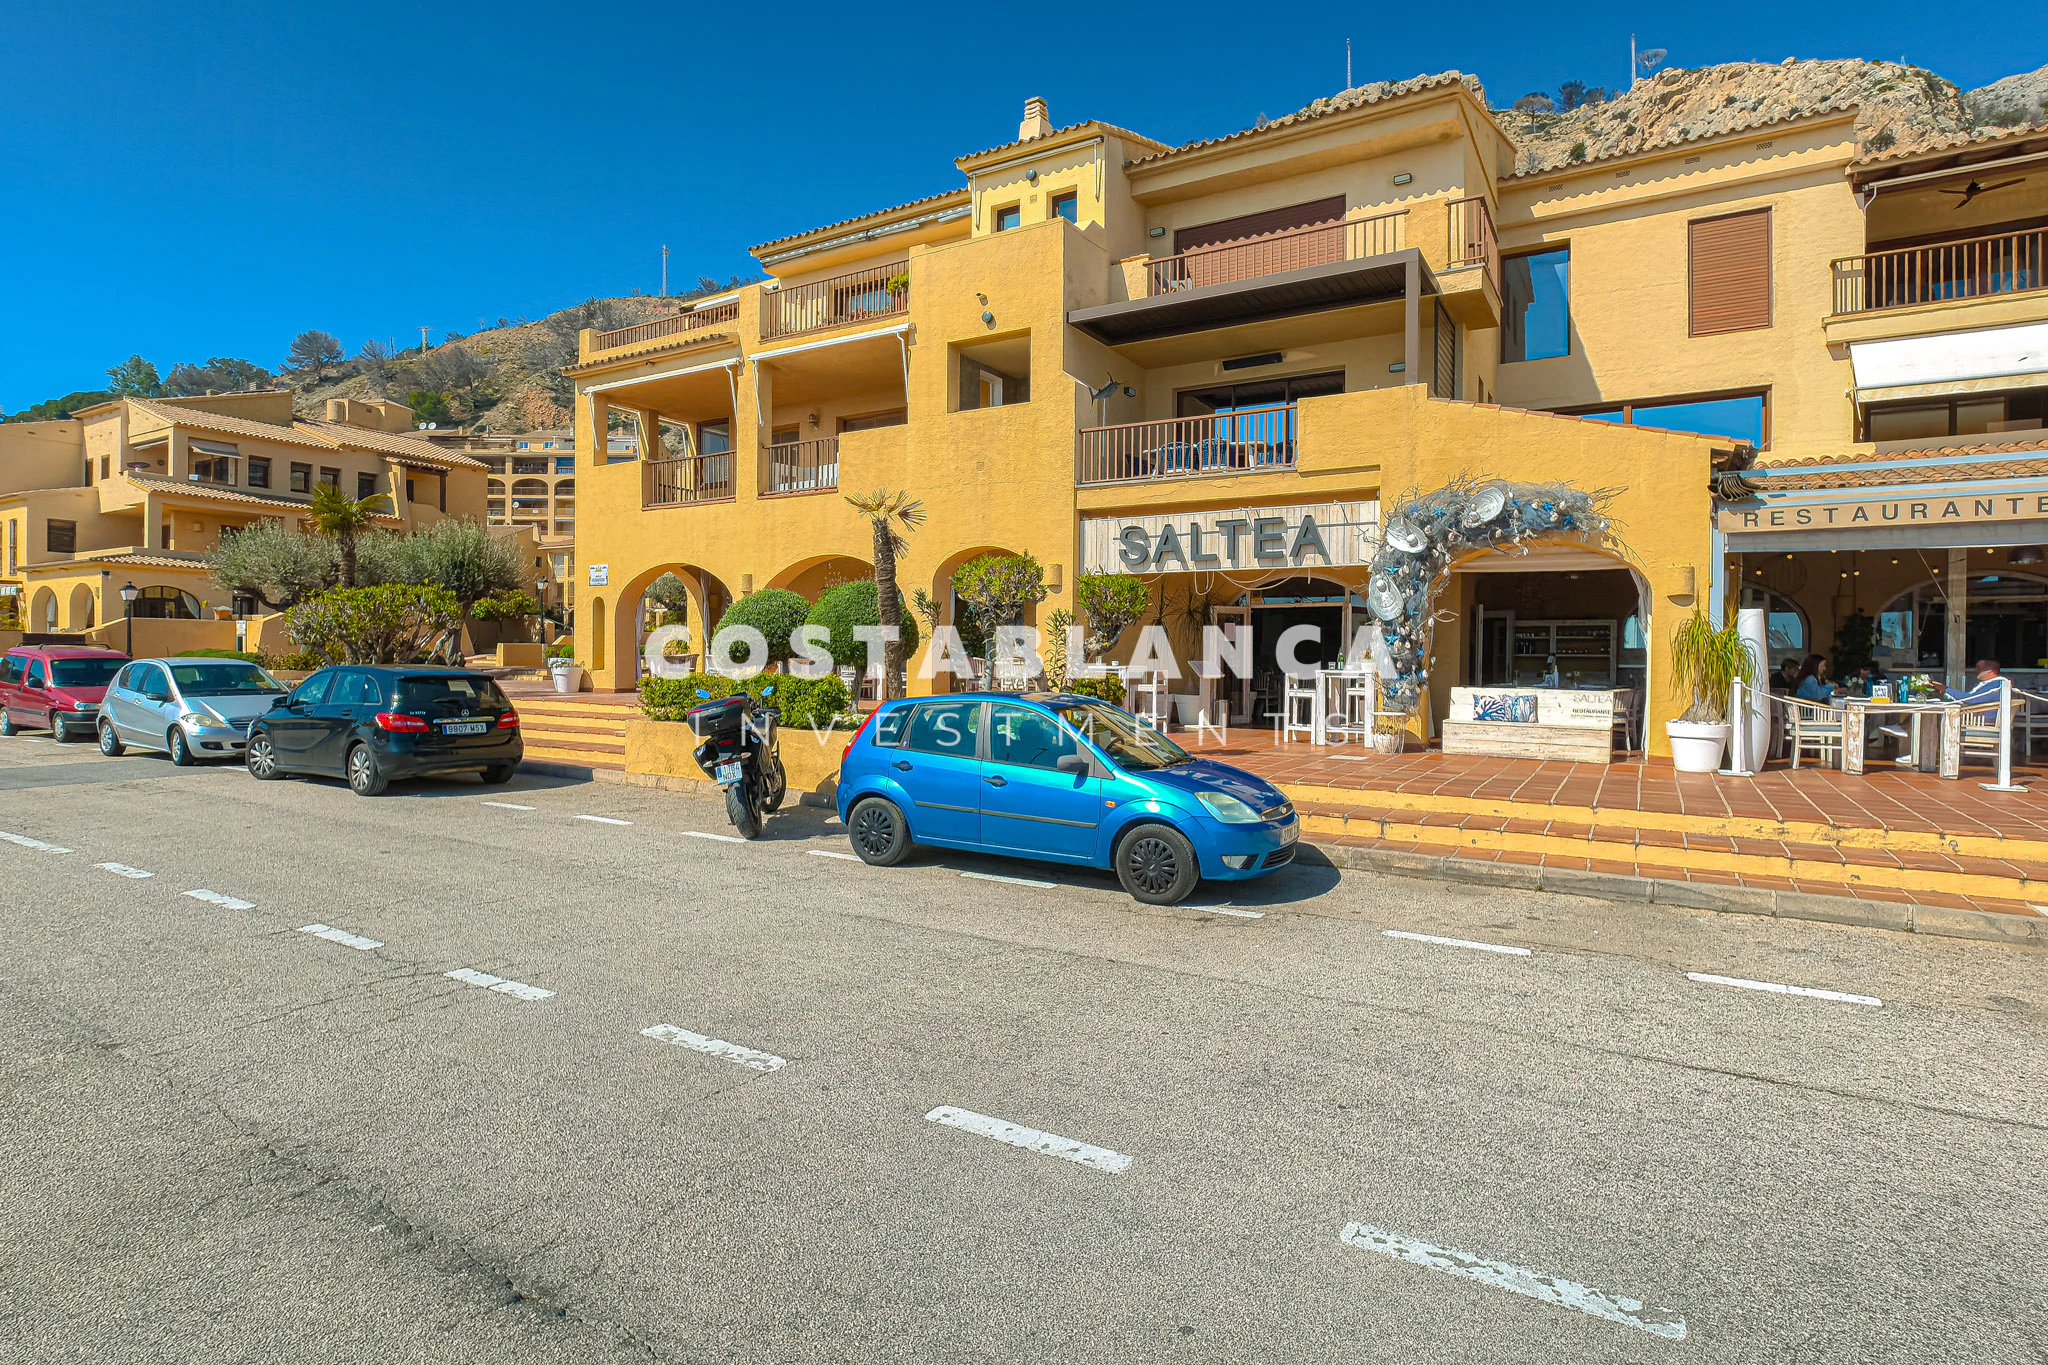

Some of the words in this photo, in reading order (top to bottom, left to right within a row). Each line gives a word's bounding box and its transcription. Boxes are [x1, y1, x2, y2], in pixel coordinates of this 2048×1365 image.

[1743, 496, 2048, 528] RESTAURANTE
[1119, 515, 1331, 566] SALTEA
[1573, 694, 1613, 704] SALTEA
